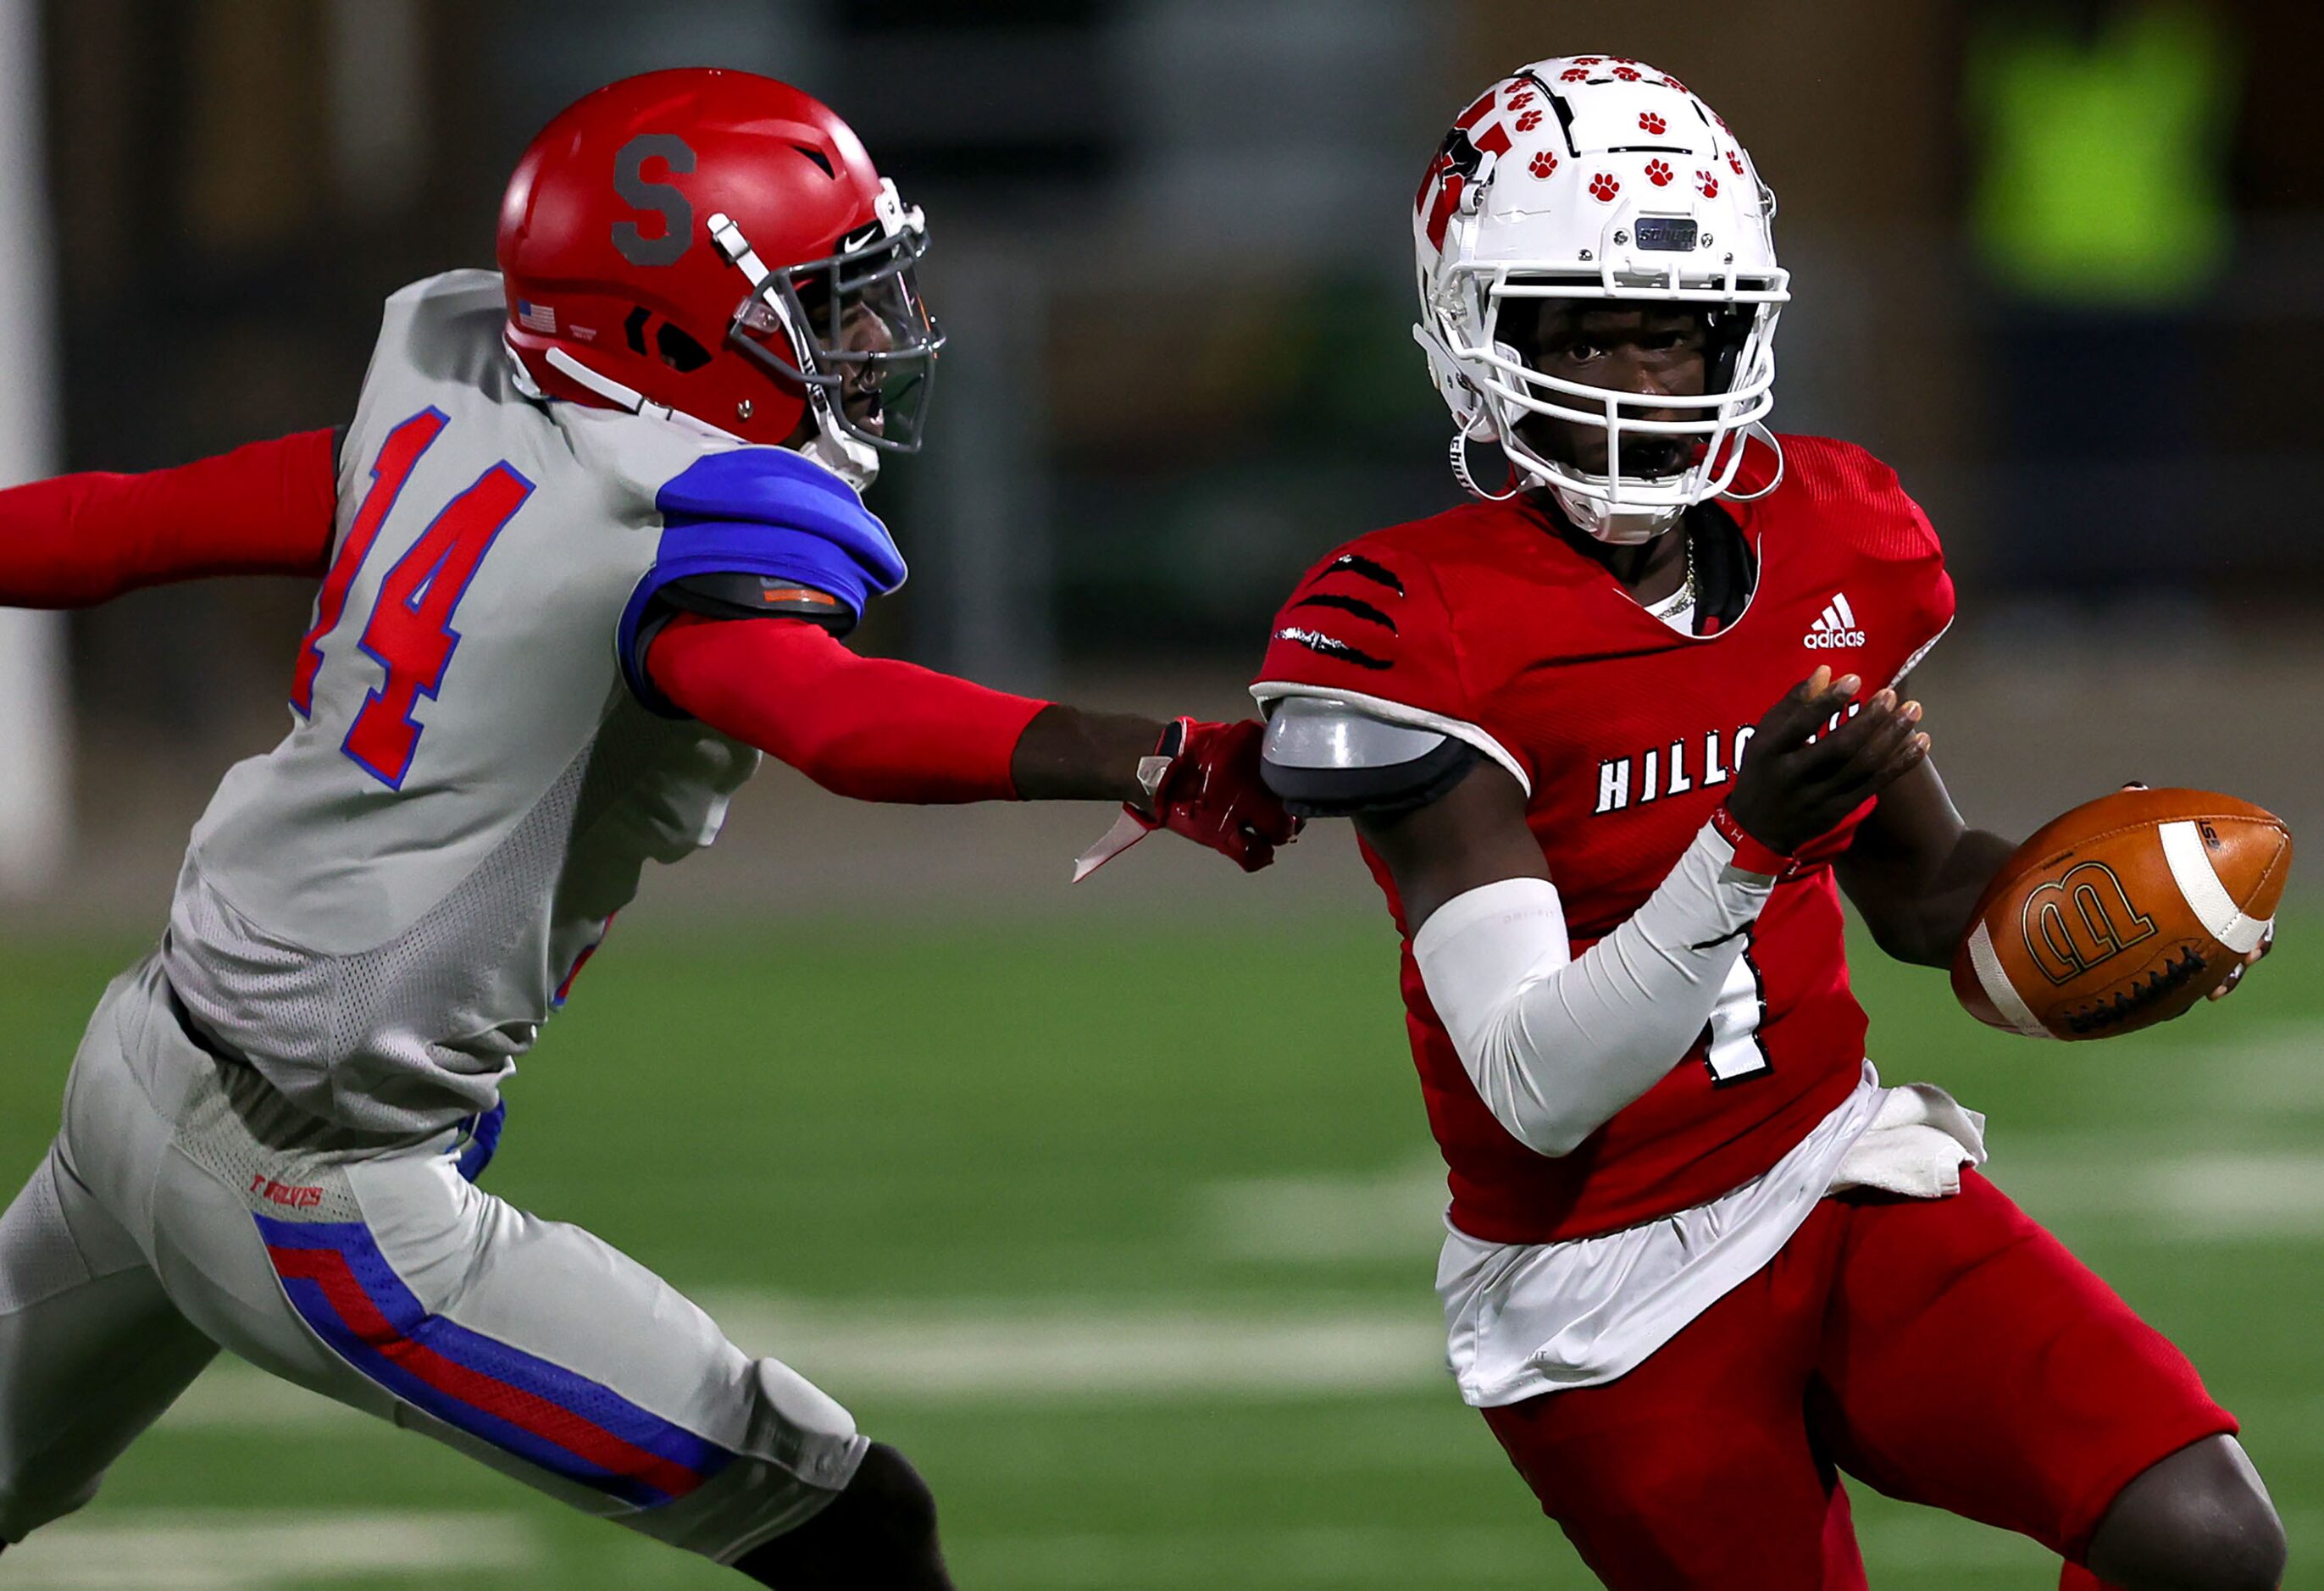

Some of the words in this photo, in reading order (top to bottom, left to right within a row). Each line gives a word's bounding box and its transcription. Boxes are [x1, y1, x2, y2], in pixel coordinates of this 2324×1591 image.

[611, 133, 697, 267] S
[288, 404, 536, 791] 14
[1803, 626, 1866, 650] adidas
[249, 1174, 266, 1193] T
